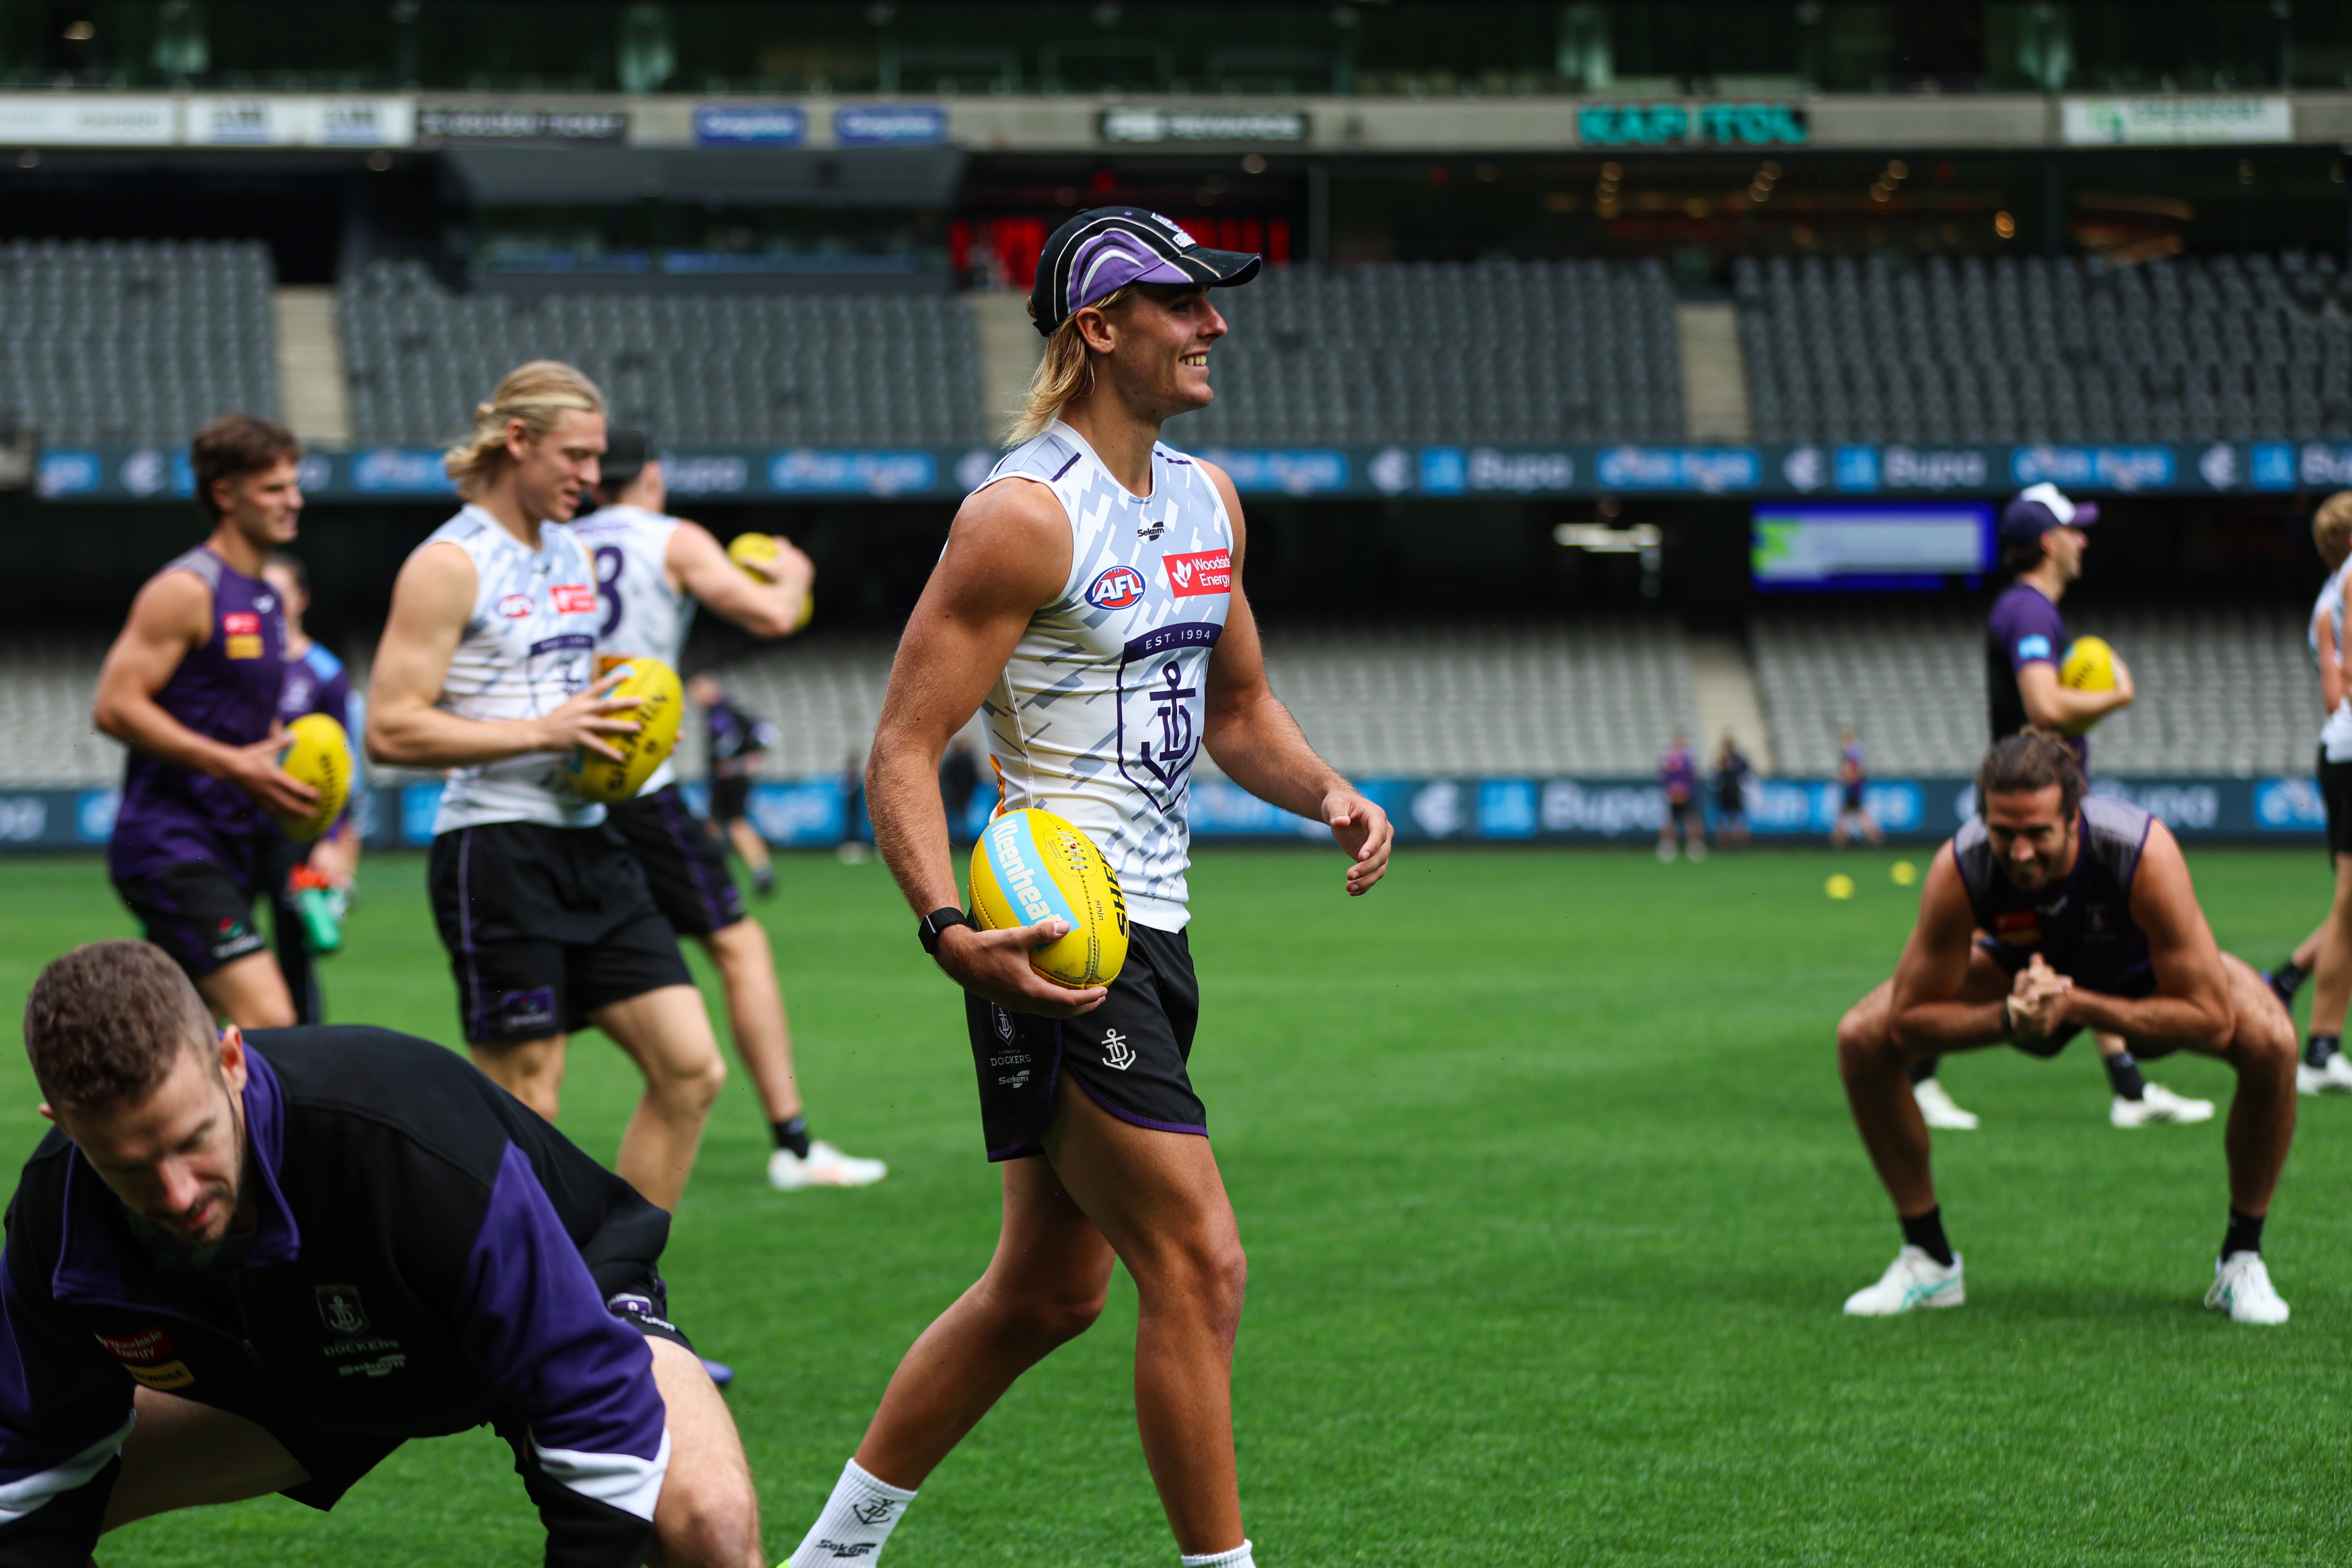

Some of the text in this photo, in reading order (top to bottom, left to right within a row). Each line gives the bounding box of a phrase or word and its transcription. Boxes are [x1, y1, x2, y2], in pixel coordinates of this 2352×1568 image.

[1468, 446, 1574, 494] Bupa
[1883, 446, 1987, 493] Bupa
[1137, 525, 1165, 539] Sekem
[1091, 573, 1144, 603] AFL
[1199, 573, 1230, 588] Energy
[1145, 629, 1210, 650] EST. 1994
[1095, 899, 1104, 921] 21/4/26
[990, 1054, 1032, 1067] DOCKERS
[998, 1074, 1029, 1085] Sekem
